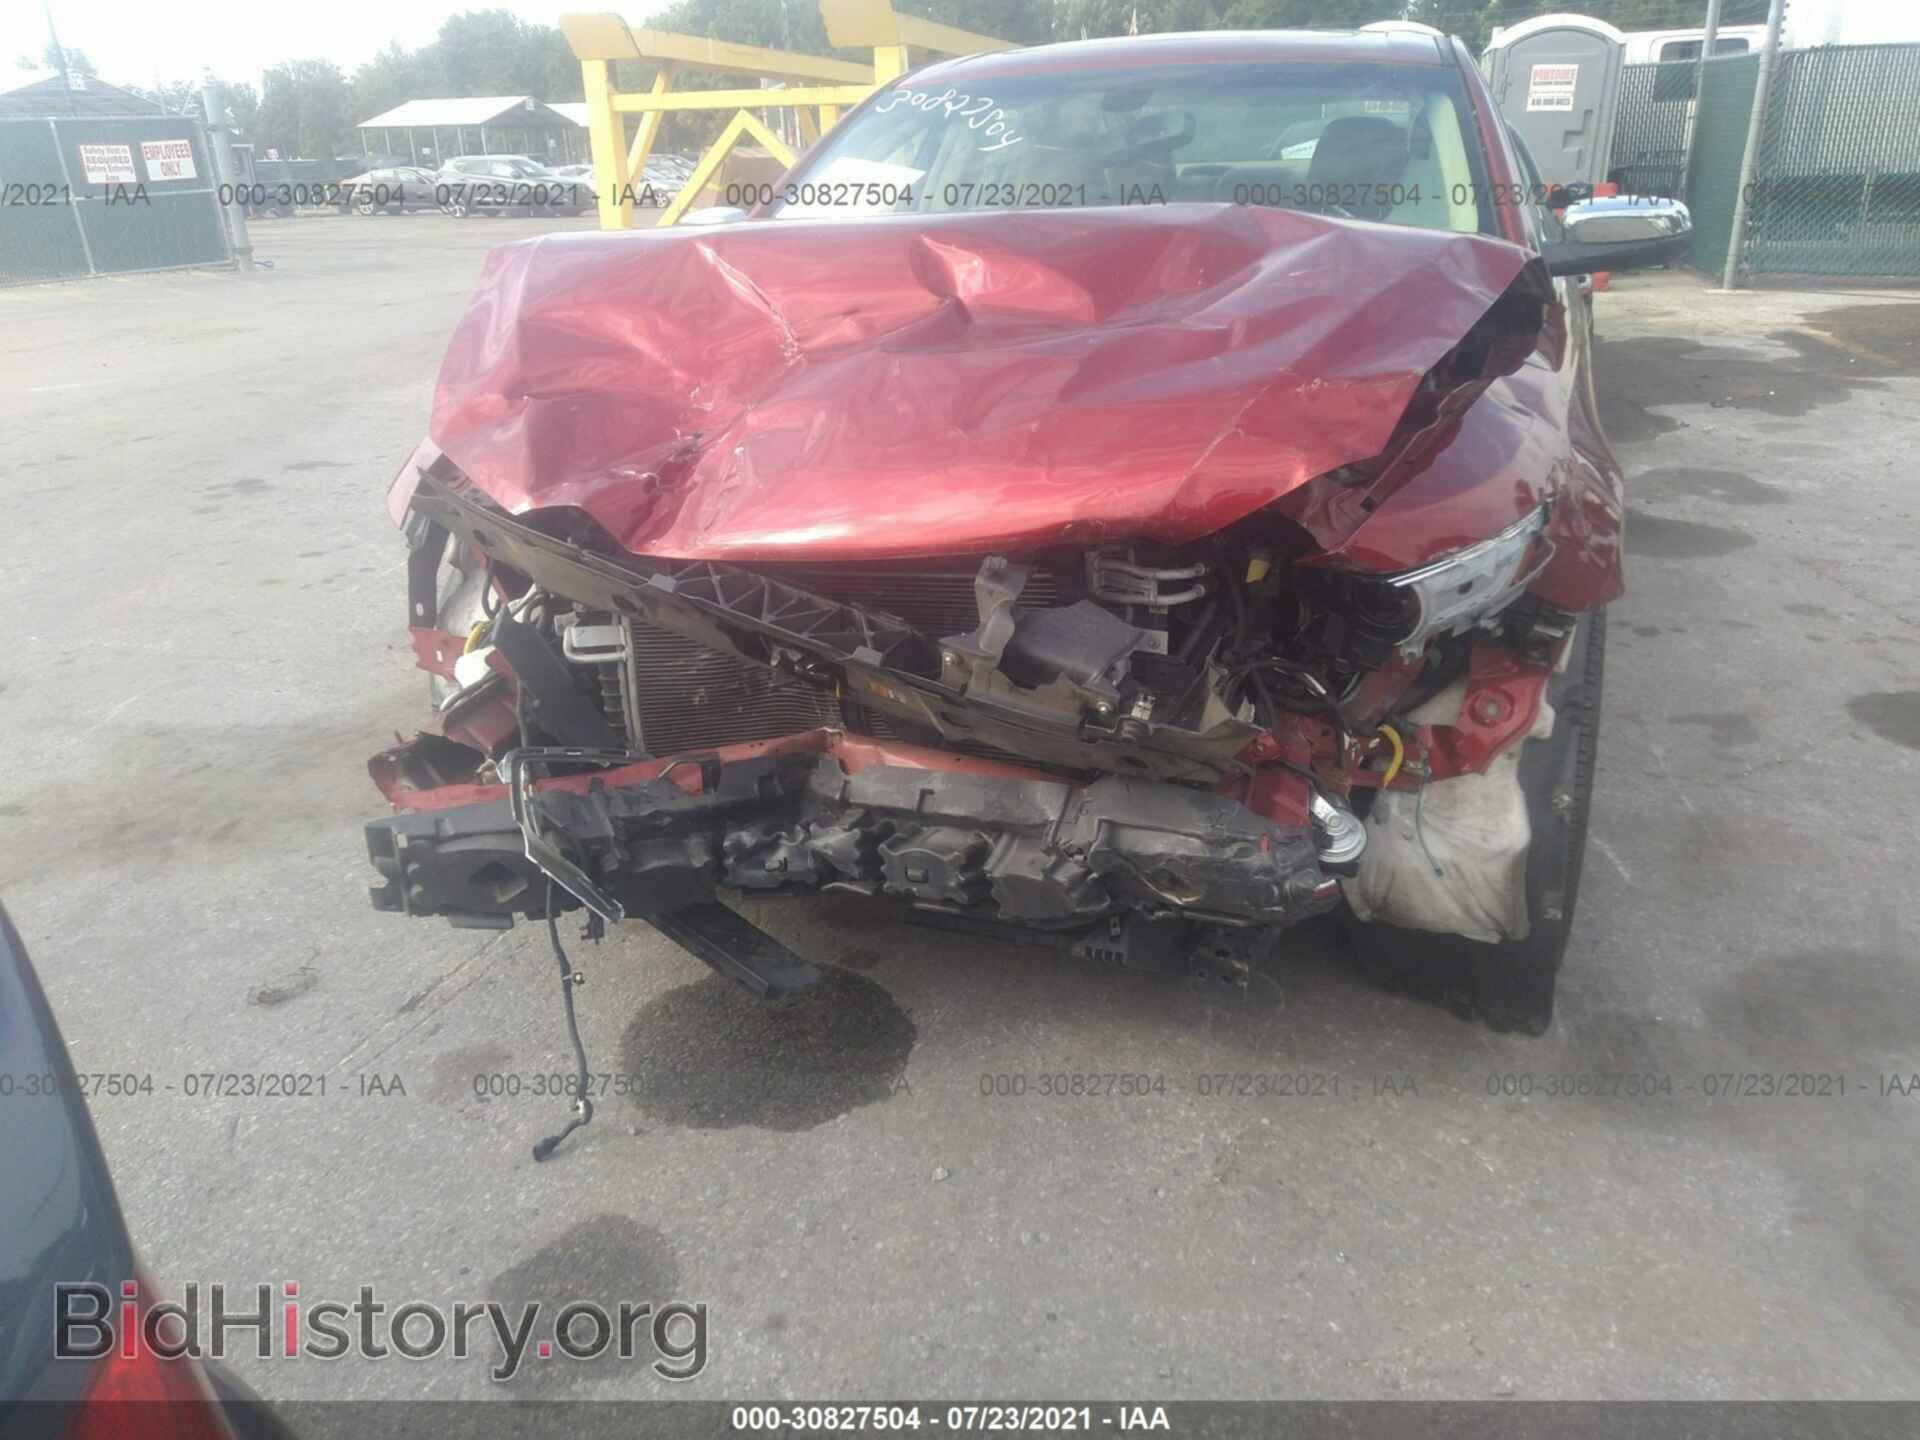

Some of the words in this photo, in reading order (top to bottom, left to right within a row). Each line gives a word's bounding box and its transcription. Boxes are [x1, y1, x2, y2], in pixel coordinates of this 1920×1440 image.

[143, 142, 192, 160] EMPLOYEES
[85, 155, 130, 165] REQUIRED
[160, 160, 181, 176] ONLY
